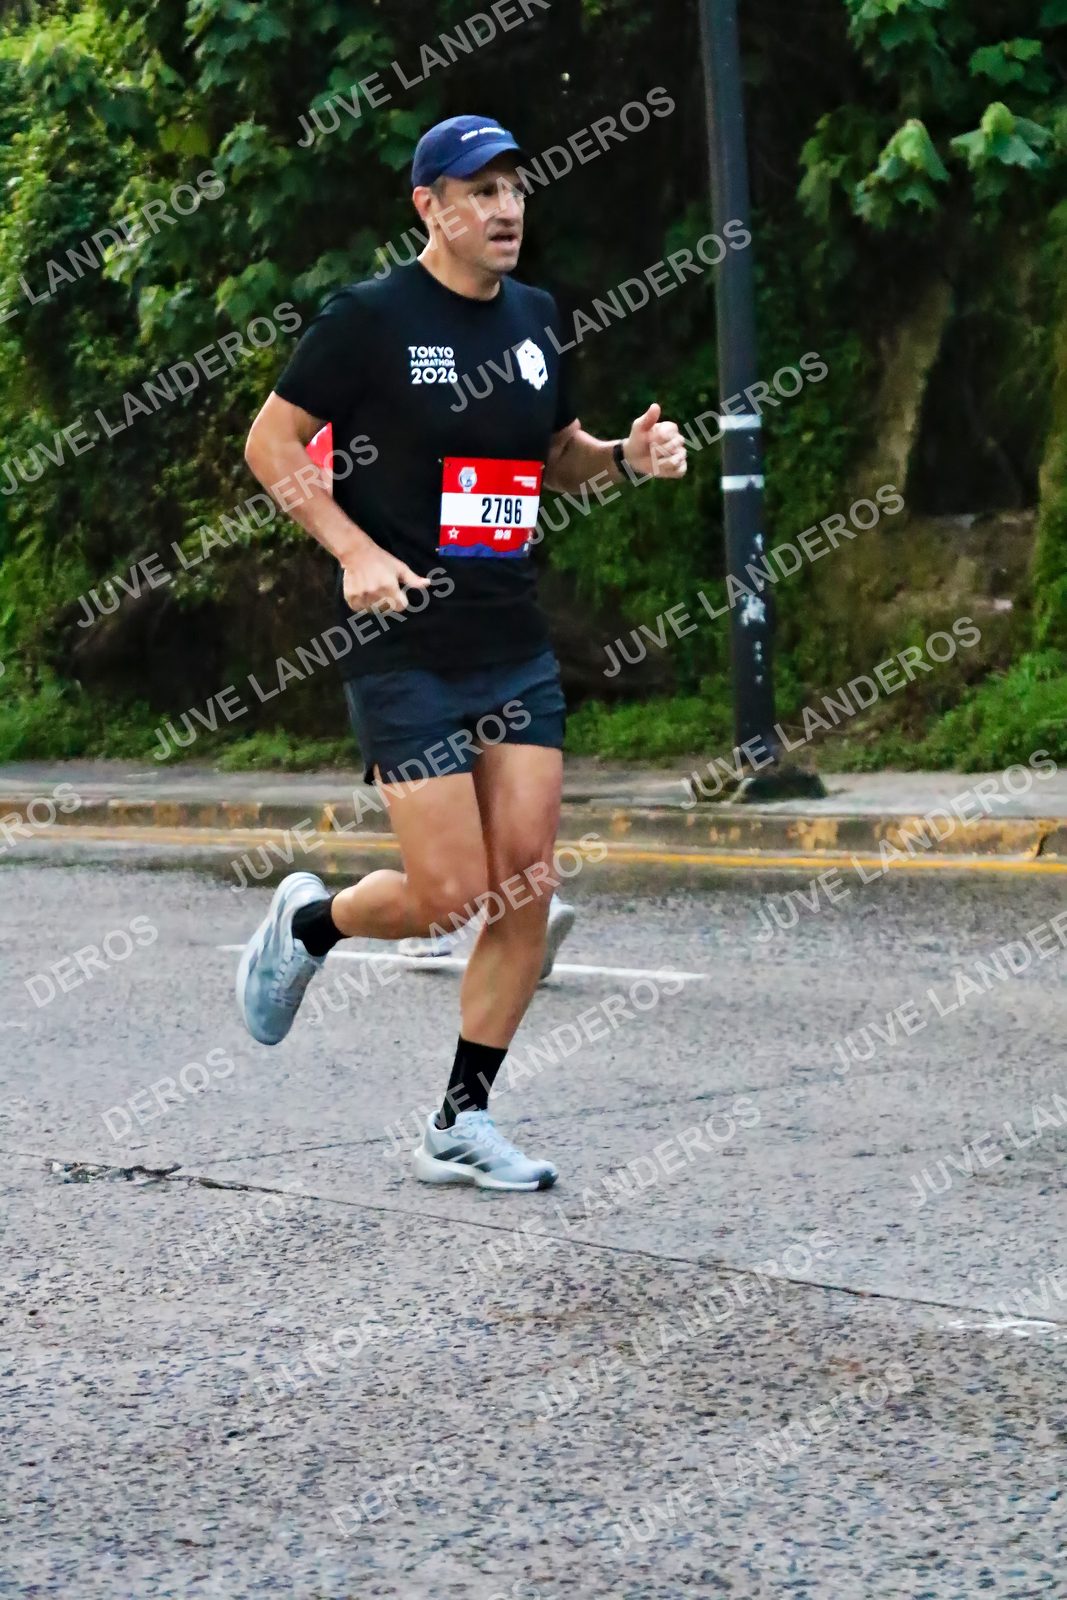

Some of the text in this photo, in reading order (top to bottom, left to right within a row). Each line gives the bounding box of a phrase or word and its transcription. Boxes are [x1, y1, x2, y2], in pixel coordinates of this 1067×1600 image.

[408, 346, 454, 358] TOKYO
[410, 358, 455, 367] MARATHON
[411, 367, 458, 384] 2026
[481, 497, 522, 524] 2796
